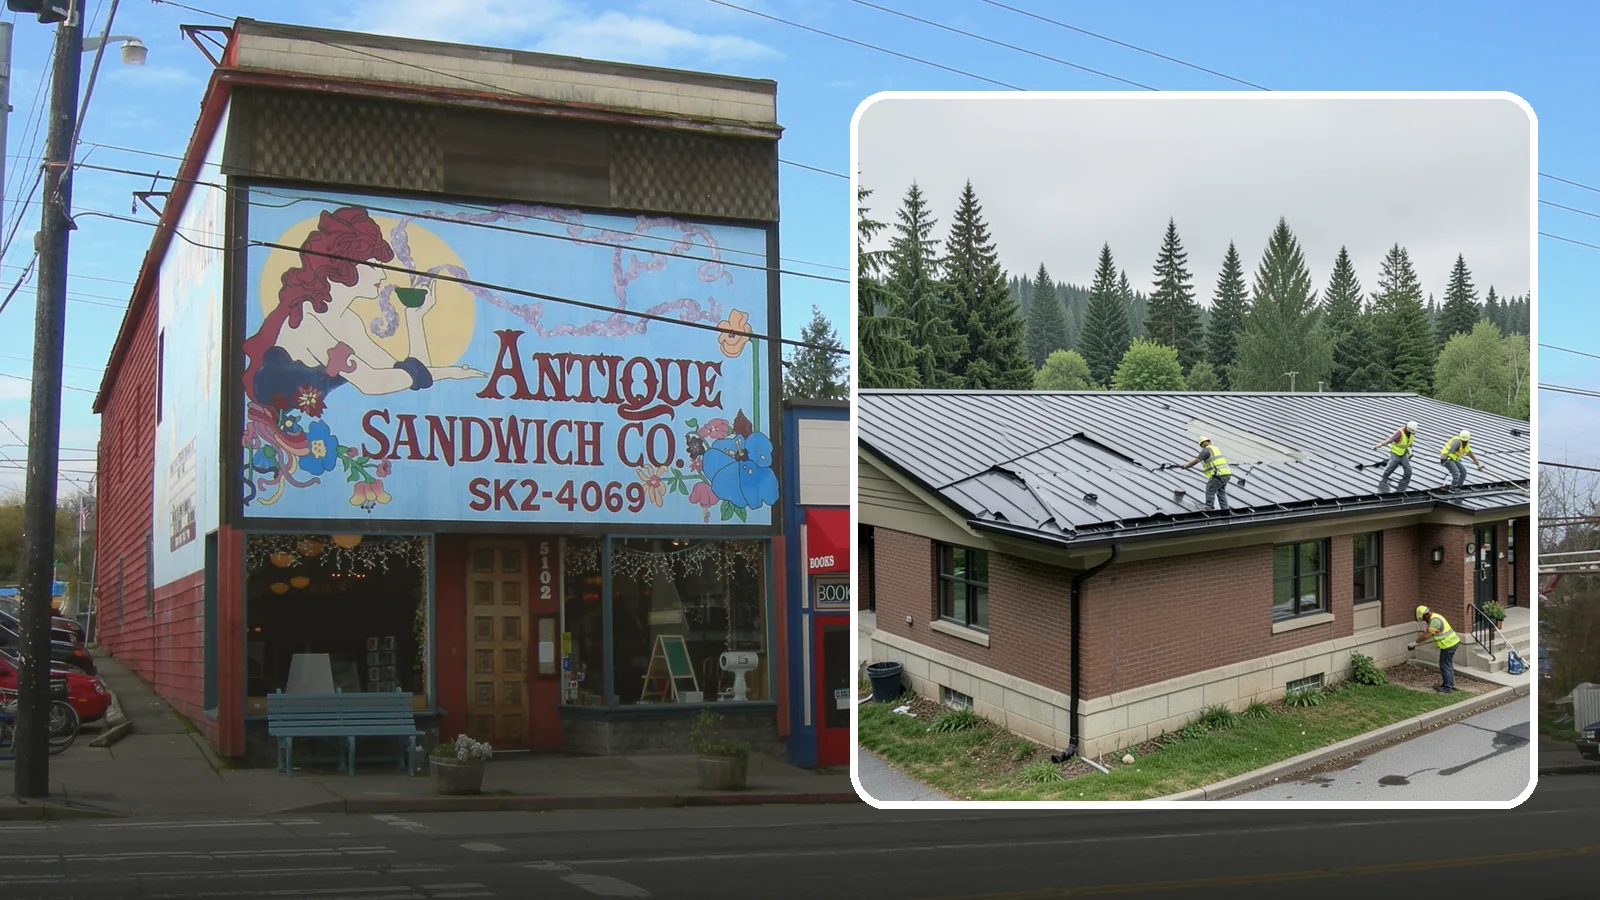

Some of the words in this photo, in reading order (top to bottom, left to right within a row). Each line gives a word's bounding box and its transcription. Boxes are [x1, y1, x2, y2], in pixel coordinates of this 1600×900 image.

[475, 328, 724, 421] ANTIQUE
[361, 408, 604, 467] SANDWICH
[617, 421, 685, 469] CO.
[468, 477, 645, 513] SK2-4069
[539, 541, 552, 600] 5102
[809, 555, 835, 569] BOOKS
